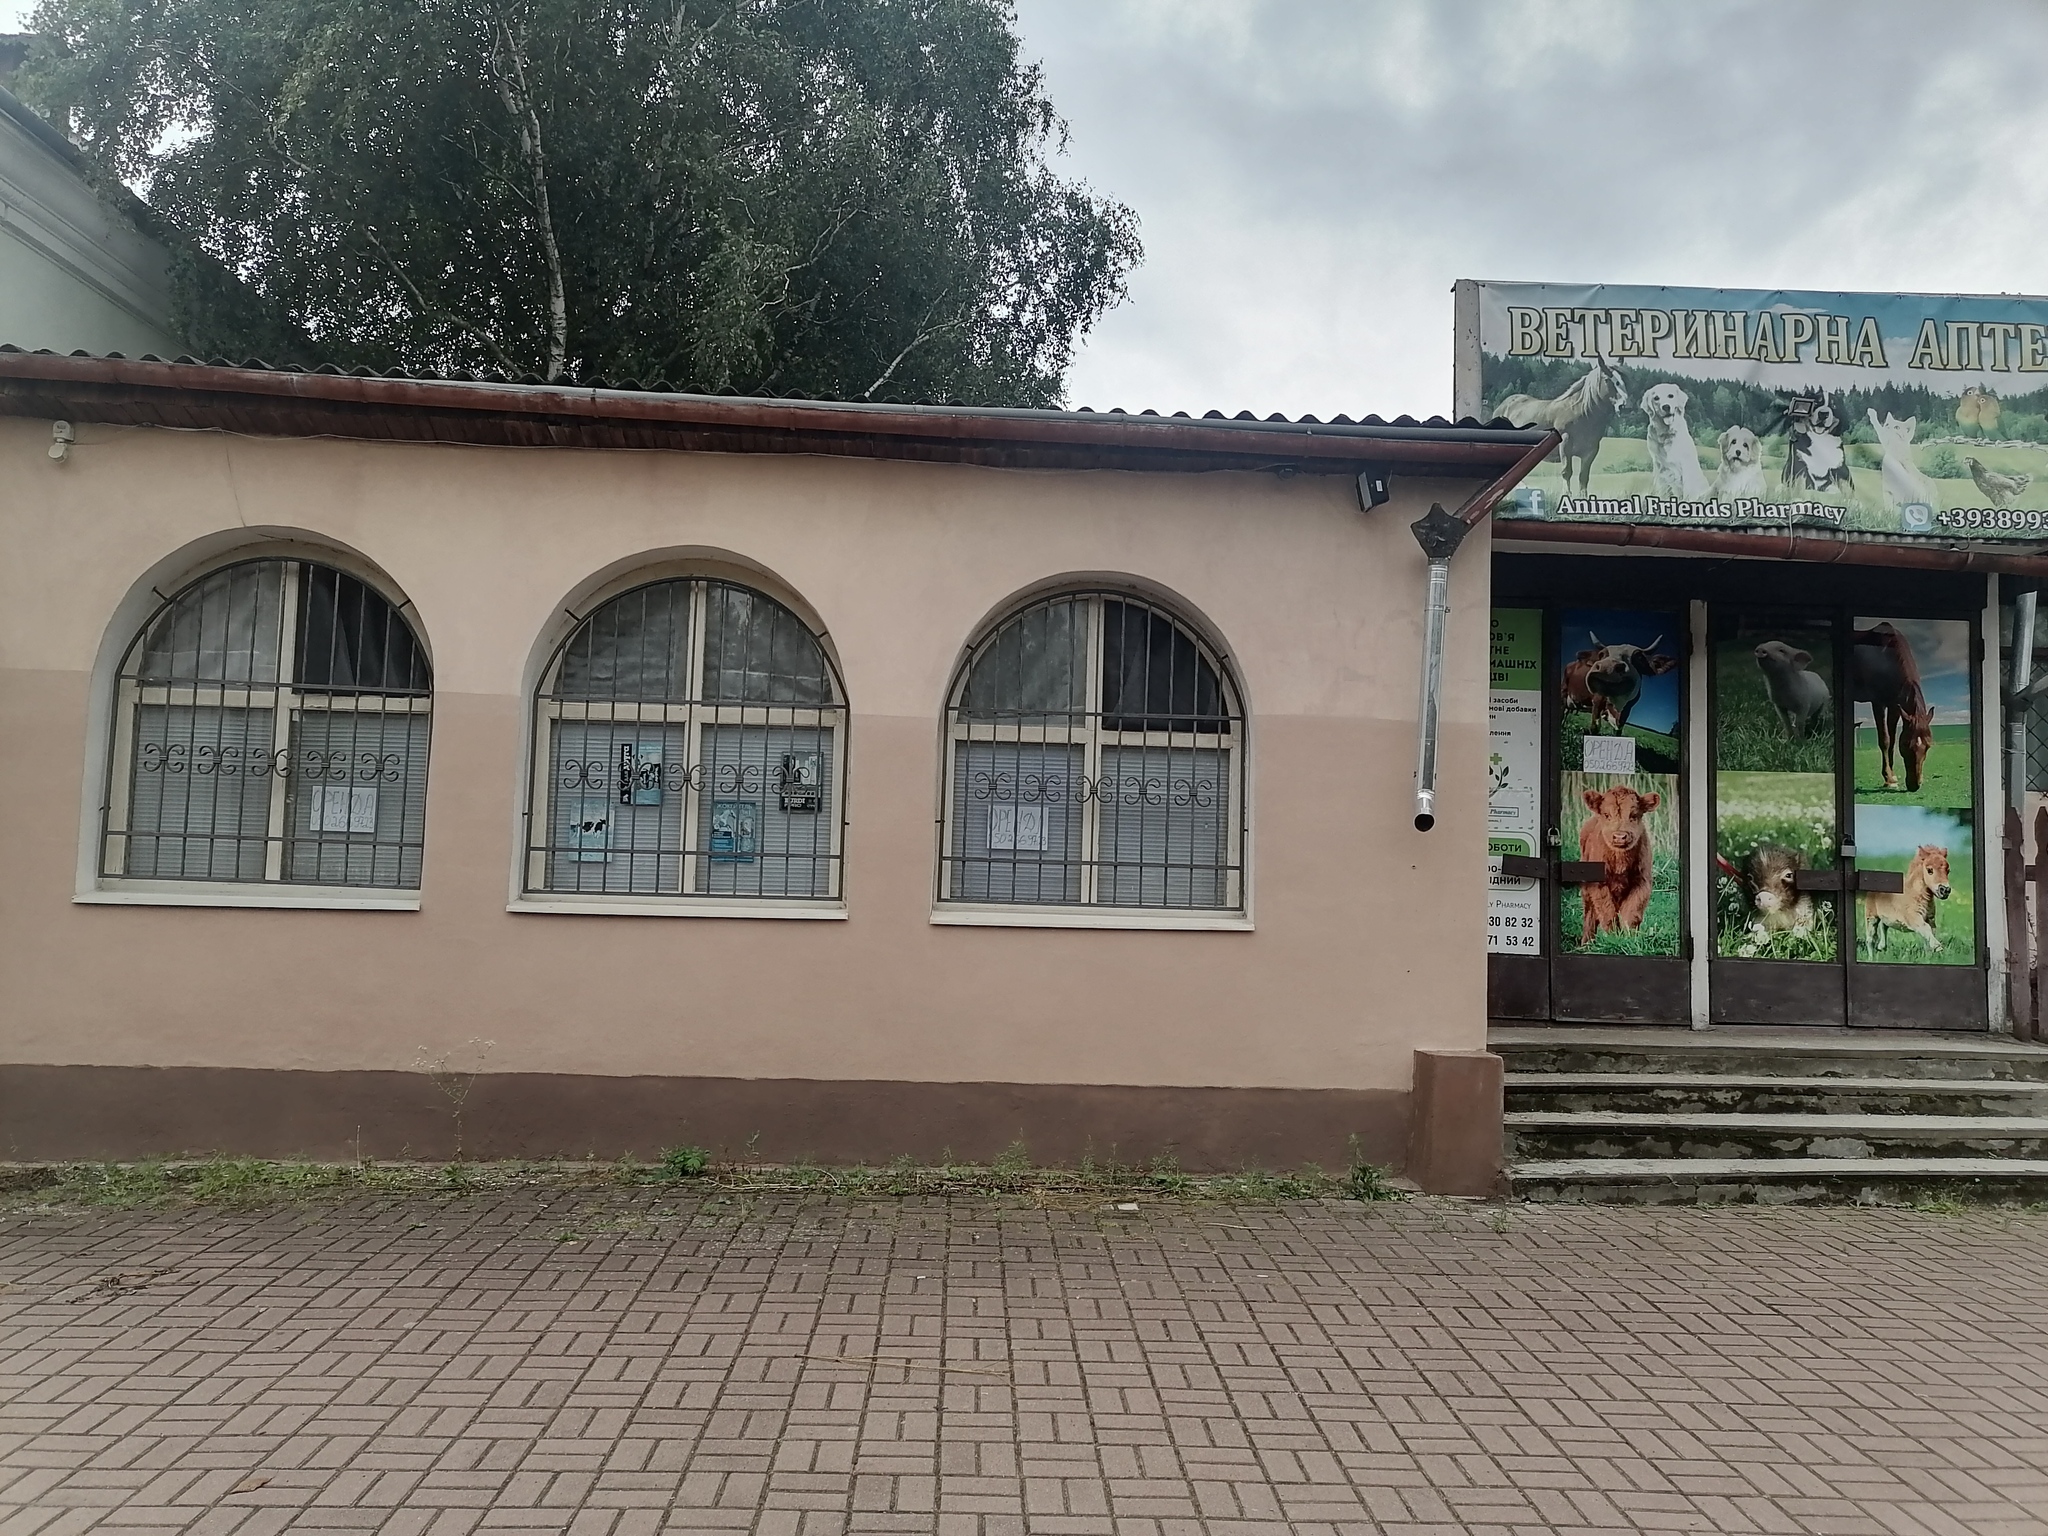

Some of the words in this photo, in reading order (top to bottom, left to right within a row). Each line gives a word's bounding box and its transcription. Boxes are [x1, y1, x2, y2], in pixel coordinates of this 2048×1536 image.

[1507, 306, 1889, 368] ВЕТЕРИНАРНА
[1557, 495, 1642, 516] Animal
[1646, 497, 1731, 518] Friends
[1735, 498, 1846, 524] Pharmacy
[1487, 916, 1501, 927] 30
[1505, 917, 1517, 928] 82
[1521, 917, 1534, 928] 32
[1506, 936, 1518, 946] 53
[1522, 936, 1535, 947] 42
